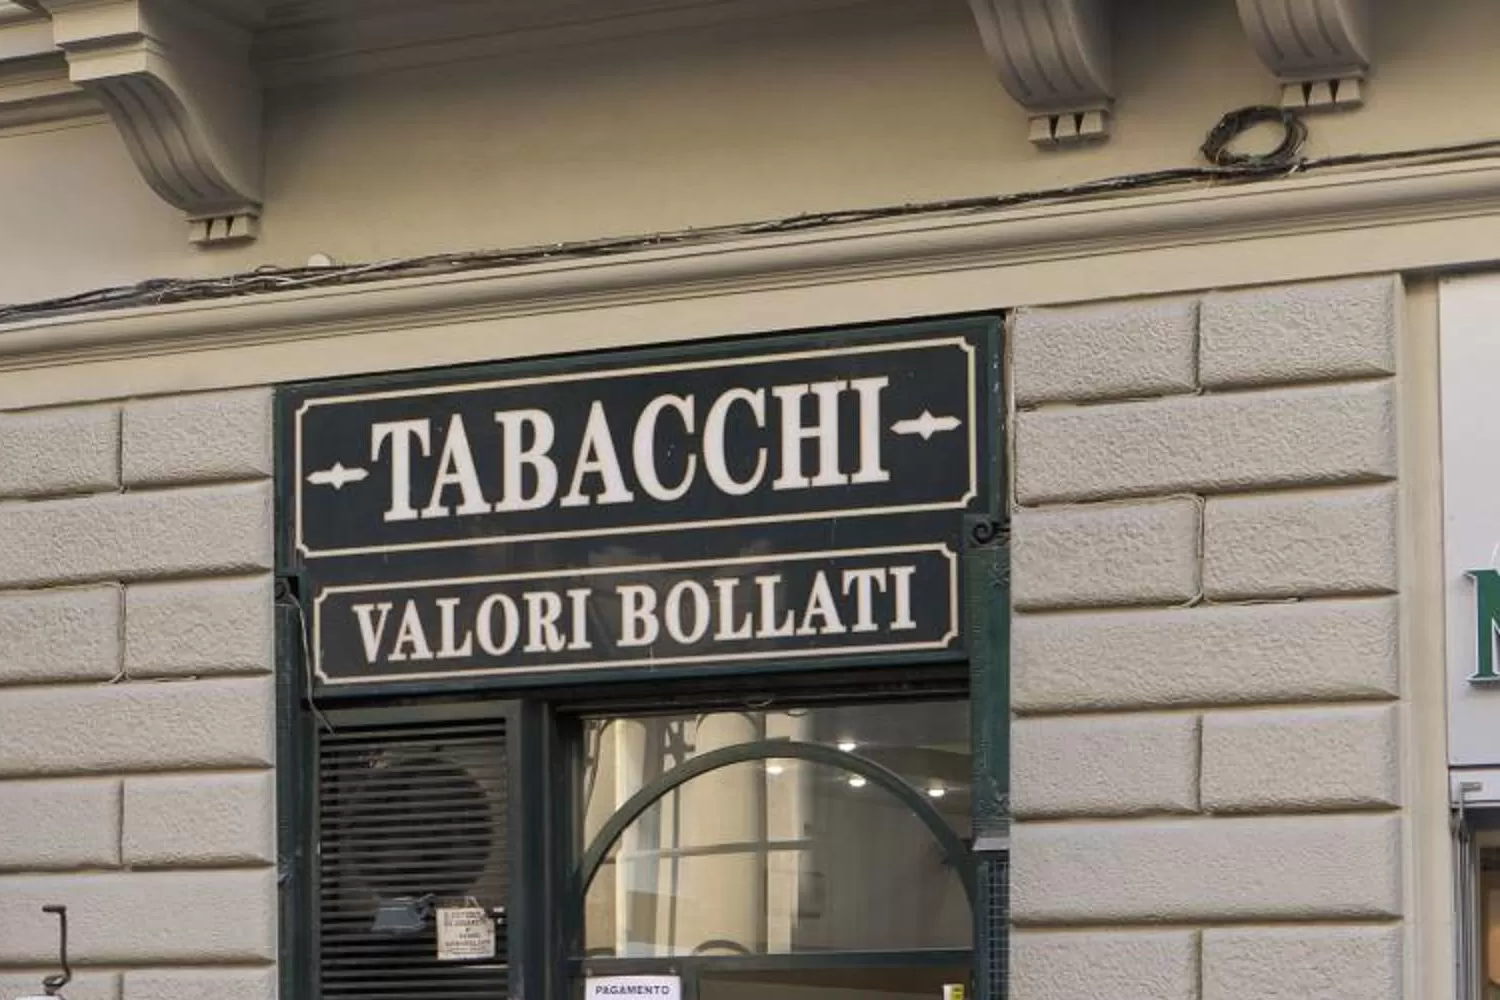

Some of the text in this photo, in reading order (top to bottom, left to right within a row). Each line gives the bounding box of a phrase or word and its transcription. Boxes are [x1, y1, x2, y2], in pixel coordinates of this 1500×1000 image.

[370, 375, 892, 523] TABACCHI
[351, 565, 918, 664] VALORI BOLLATI
[595, 985, 671, 995] PAGAMENTO
